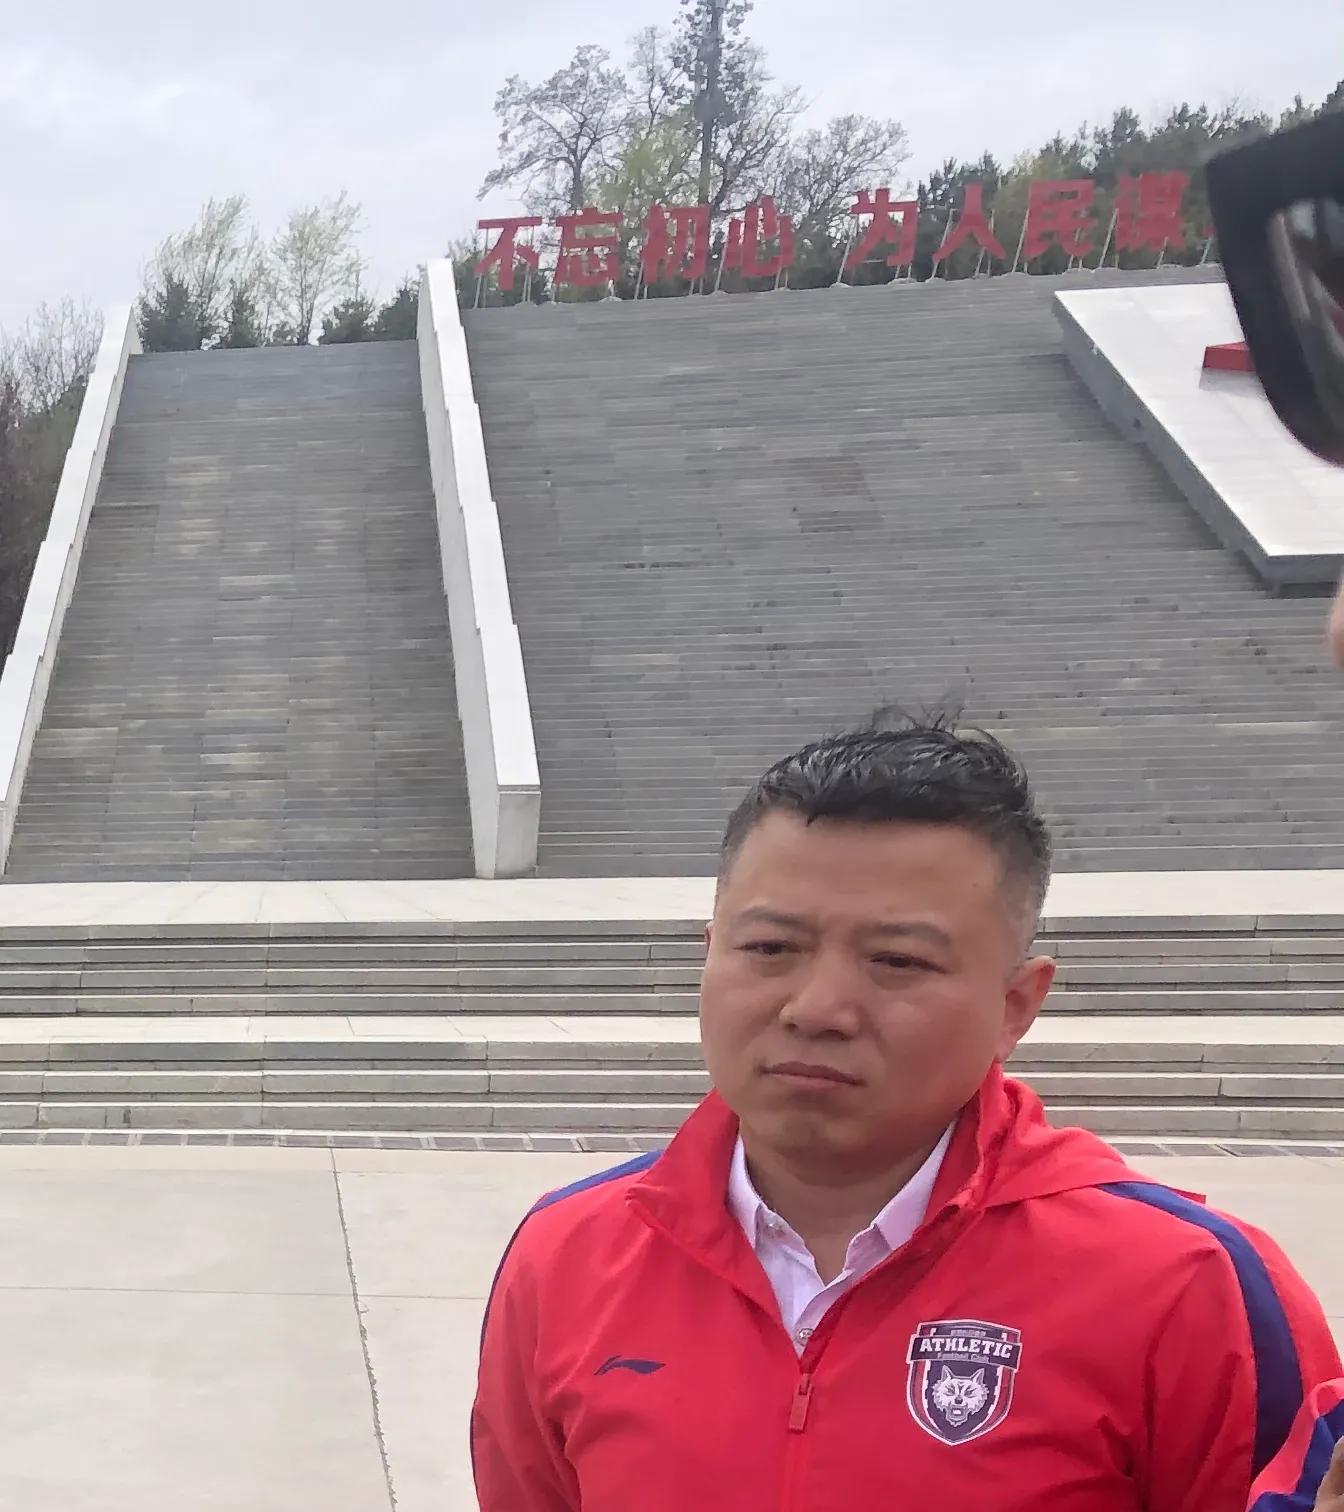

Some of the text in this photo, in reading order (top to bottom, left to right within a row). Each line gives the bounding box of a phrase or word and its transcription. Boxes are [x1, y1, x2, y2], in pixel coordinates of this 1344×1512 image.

[475, 169, 1215, 291] 不忘初心 为人民谋
[919, 1337, 1013, 1359] ATHLETIC
